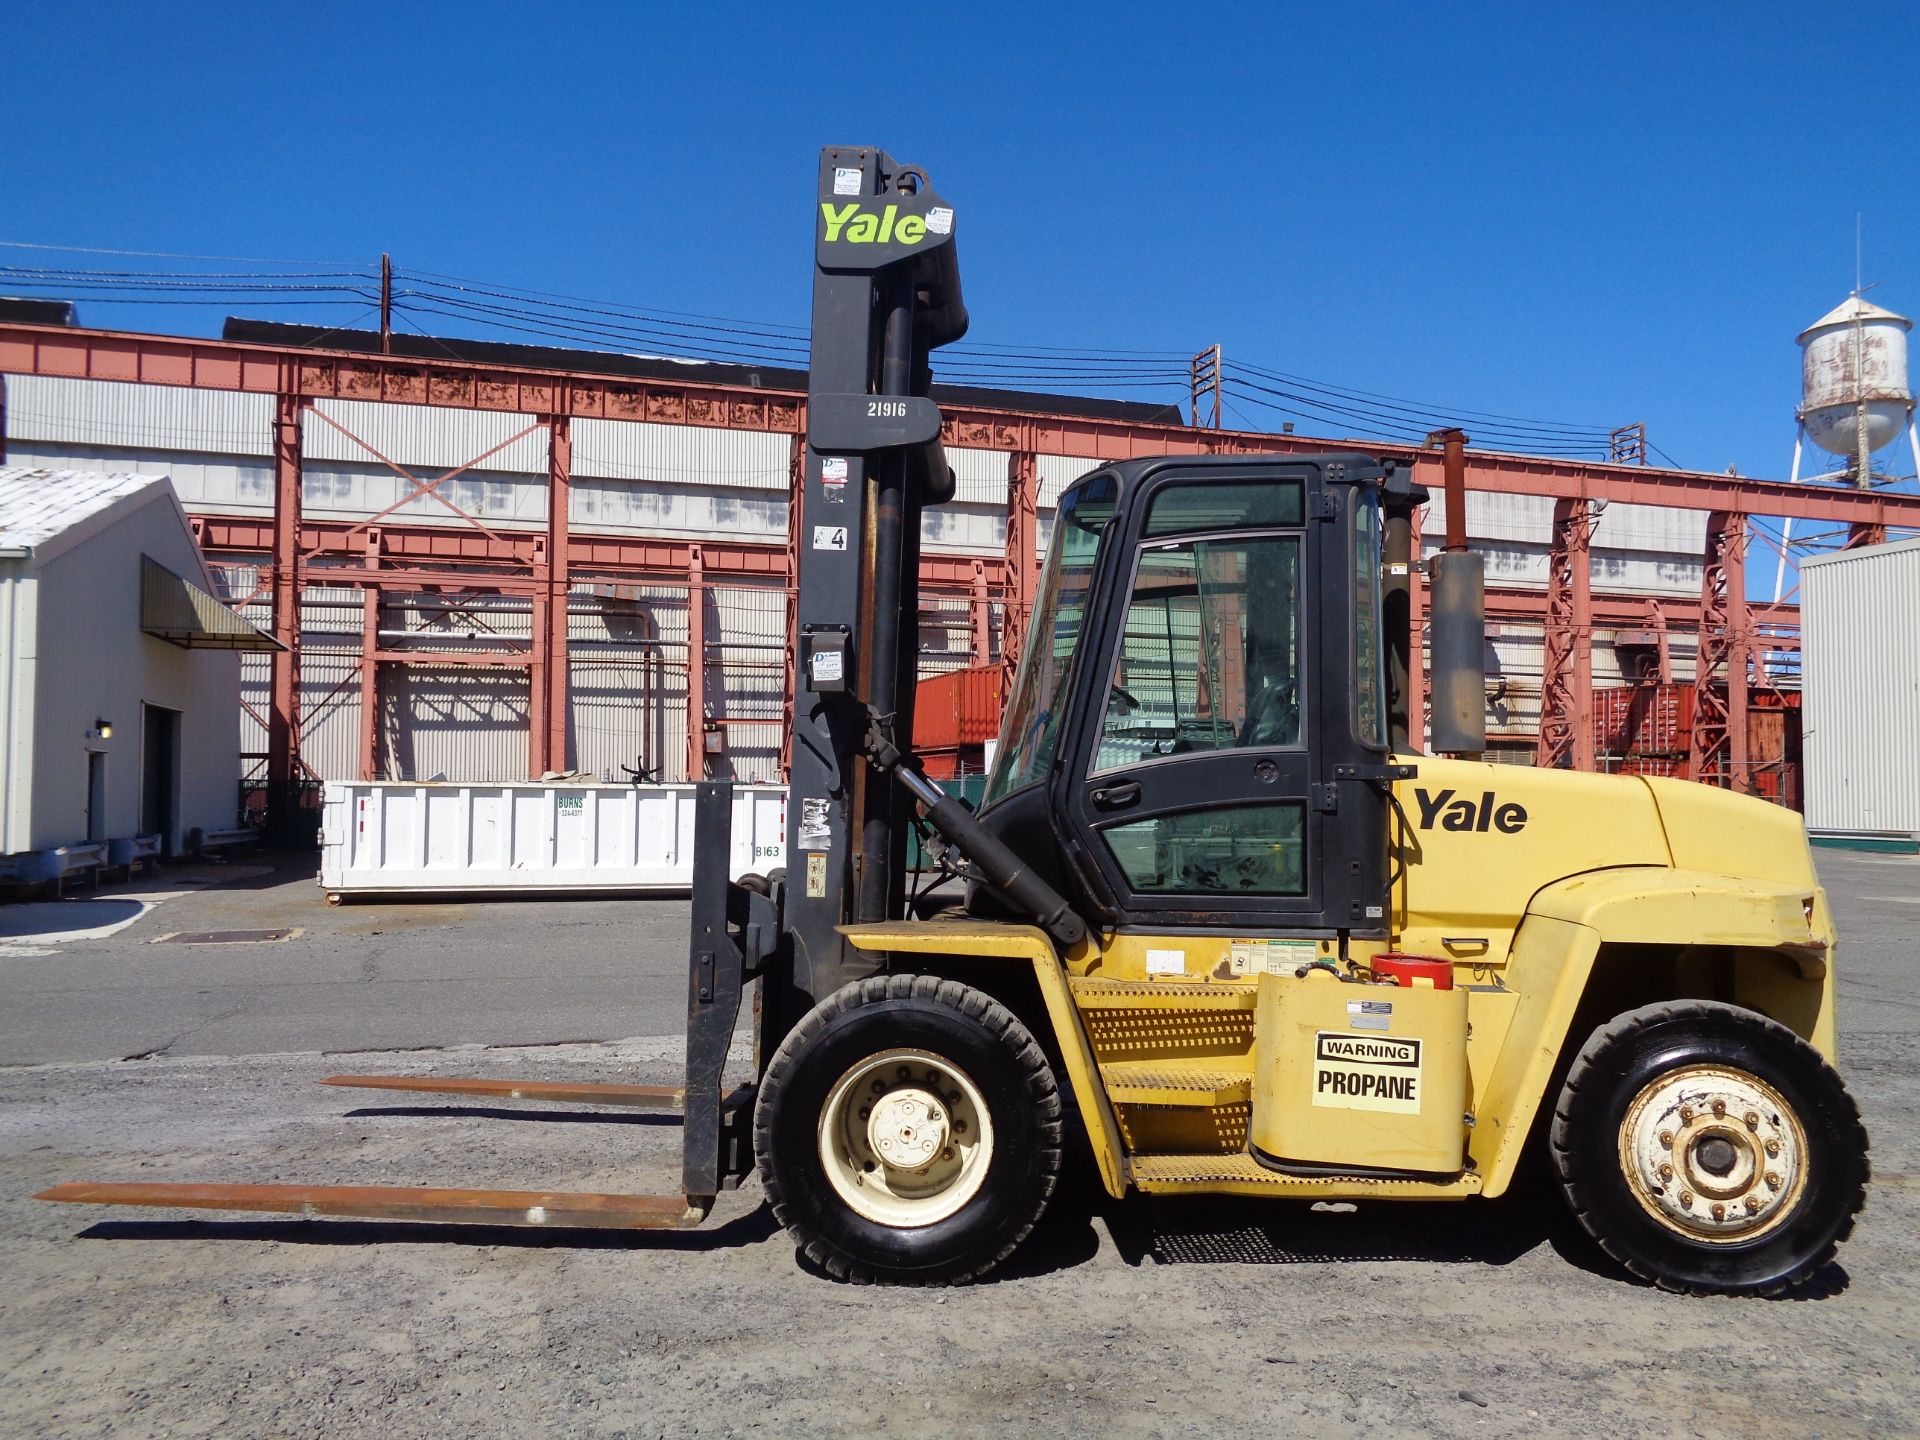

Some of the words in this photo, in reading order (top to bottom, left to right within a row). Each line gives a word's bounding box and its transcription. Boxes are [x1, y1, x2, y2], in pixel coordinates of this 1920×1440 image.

[821, 203, 927, 245] Yale
[867, 402, 907, 417] 21916
[558, 797, 583, 809] BURNS
[1414, 788, 1528, 834] Yale
[755, 846, 780, 857] B163
[1327, 1041, 1410, 1060] WARNING
[1317, 1070, 1417, 1101] PROPANE
